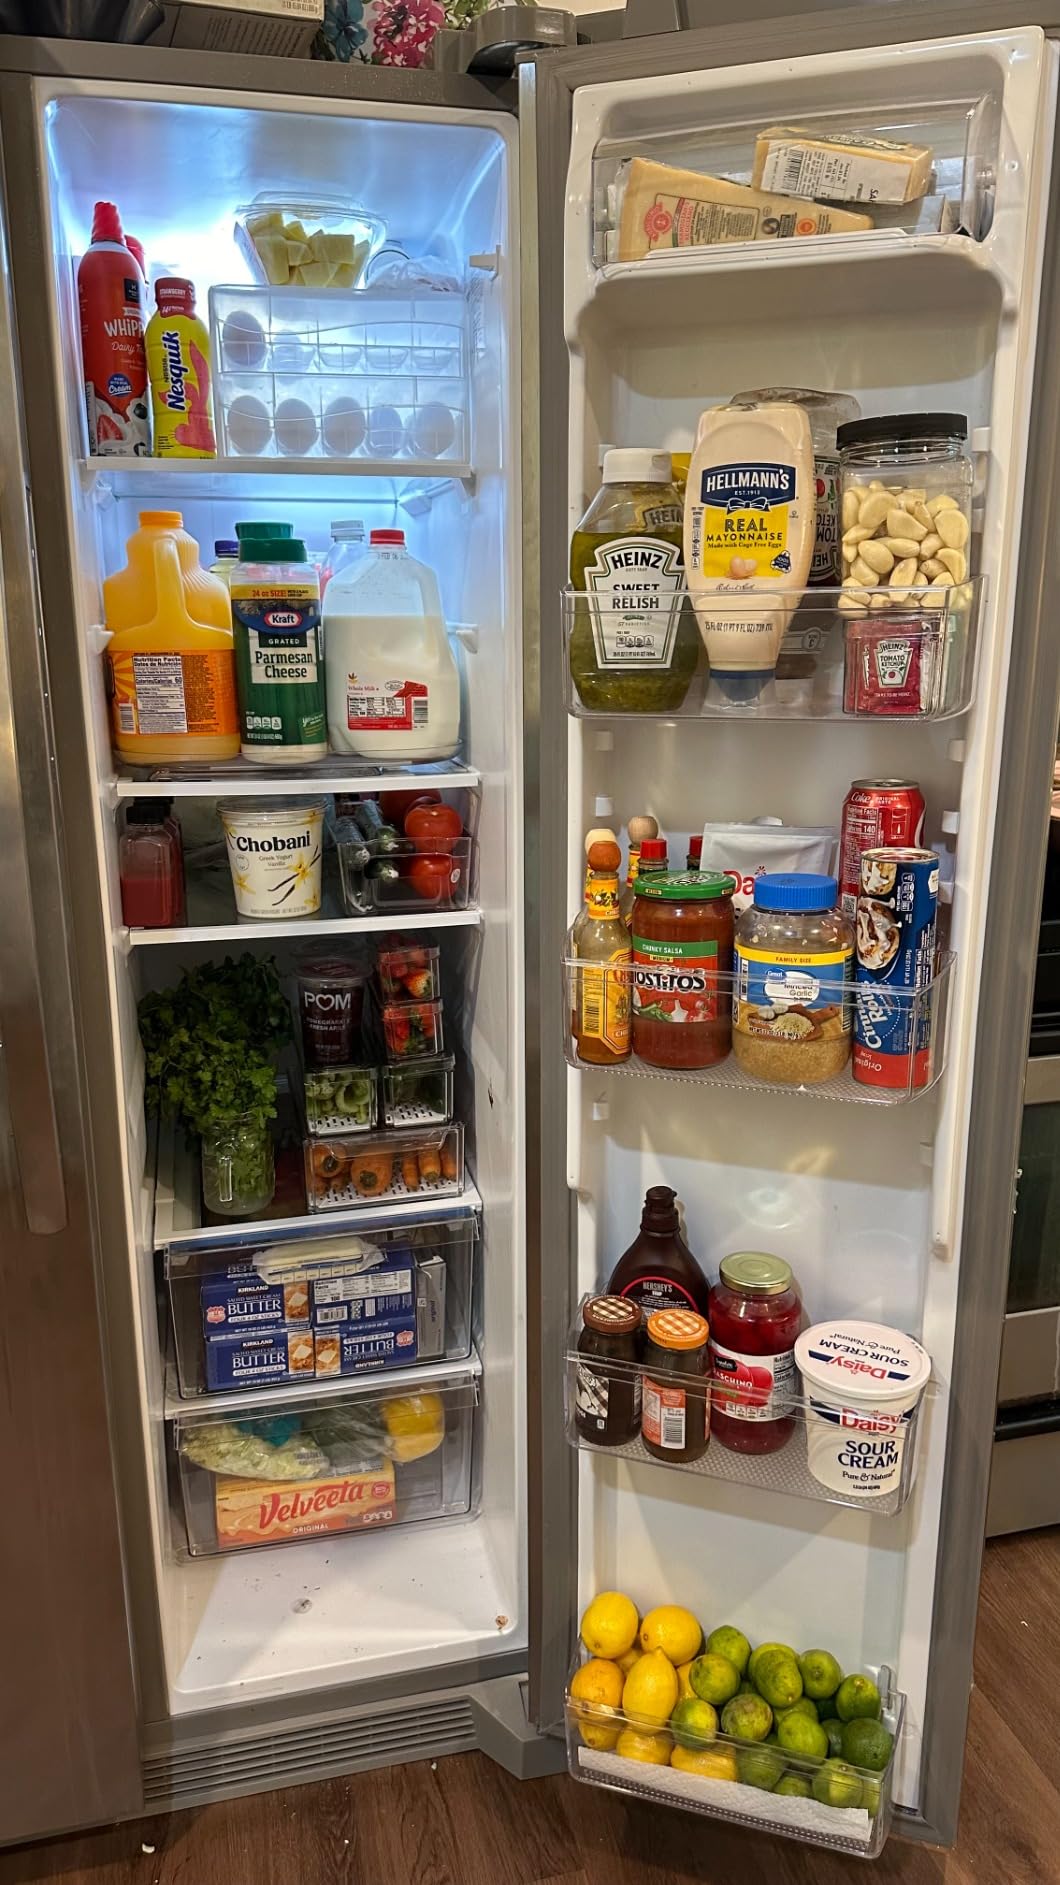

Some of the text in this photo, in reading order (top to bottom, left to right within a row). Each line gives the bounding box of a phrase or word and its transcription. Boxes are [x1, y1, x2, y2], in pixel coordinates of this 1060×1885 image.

[162, 330, 189, 412] Nesquik
[108, 384, 132, 394] Cream
[706, 468, 790, 493] HELLMANN'S
[724, 518, 768, 532] REAL
[706, 532, 783, 542] MAYONNAISE
[738, 541, 752, 549] Cage
[768, 541, 782, 550] Eggs
[611, 552, 663, 569] HEINZ
[612, 598, 660, 609] RELISH
[272, 614, 295, 624] Kraft
[255, 651, 313, 664] Parmesan
[264, 665, 308, 678] Cheese
[851, 792, 871, 803] Coke
[863, 825, 876, 833] 140
[236, 830, 310, 852] Chobani
[642, 944, 662, 952] CHUNKY
[790, 989, 813, 998] Garlic
[304, 991, 351, 1011] POM
[238, 1285, 269, 1293] KIRKLAND
[643, 1282, 673, 1292] HERSHEY'S
[228, 1300, 281, 1315] BUTTER
[242, 1339, 273, 1347] KIRKLAND
[344, 1339, 395, 1355] BUTTER
[831, 1333, 900, 1355] Pure & Natural
[818, 1339, 910, 1367] SOUR CREAM
[233, 1352, 286, 1368] BUTTER
[830, 1355, 887, 1380] Daisy
[845, 1440, 896, 1454] SOUR
[837, 1453, 899, 1469] CREAM
[842, 1469, 895, 1481] Pure & Natural
[259, 1481, 364, 1529] Velveeta
[292, 1523, 329, 1534] ORIGINAL
